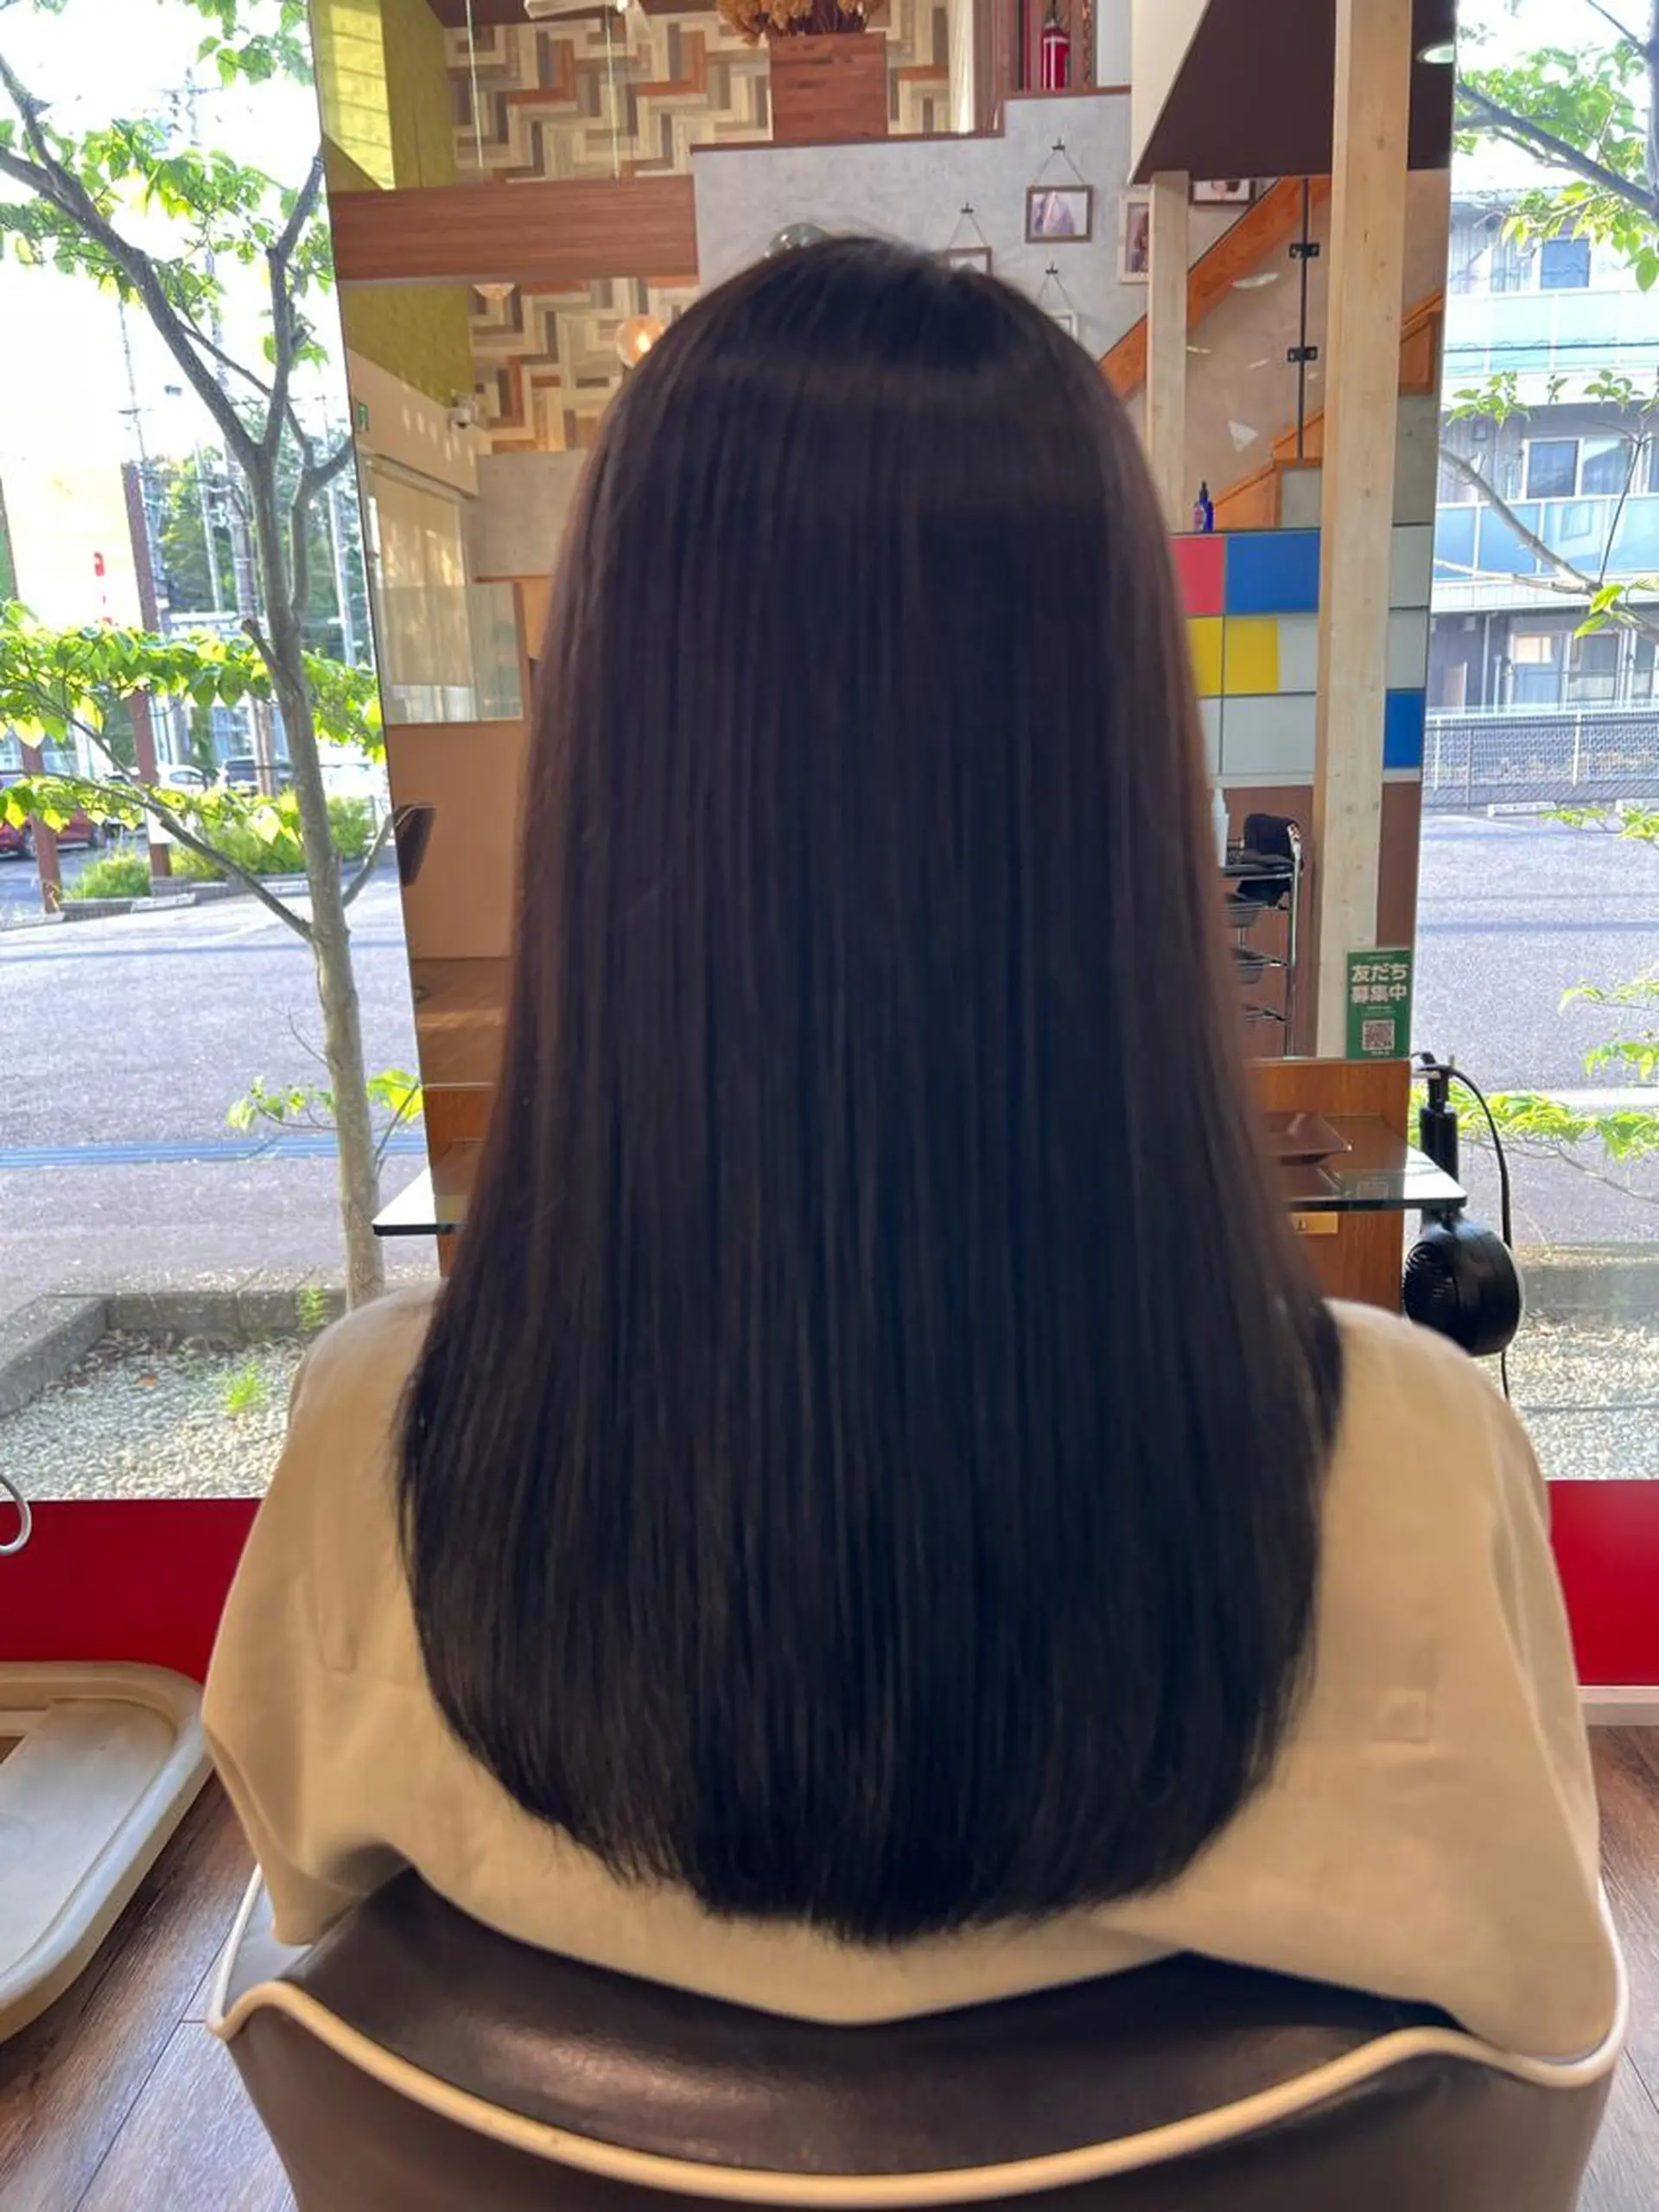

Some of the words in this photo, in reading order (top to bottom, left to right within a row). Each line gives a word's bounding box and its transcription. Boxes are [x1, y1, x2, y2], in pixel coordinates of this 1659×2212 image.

[1351, 963, 1408, 982] 友だち
[1351, 983, 1407, 1003] 募集中
